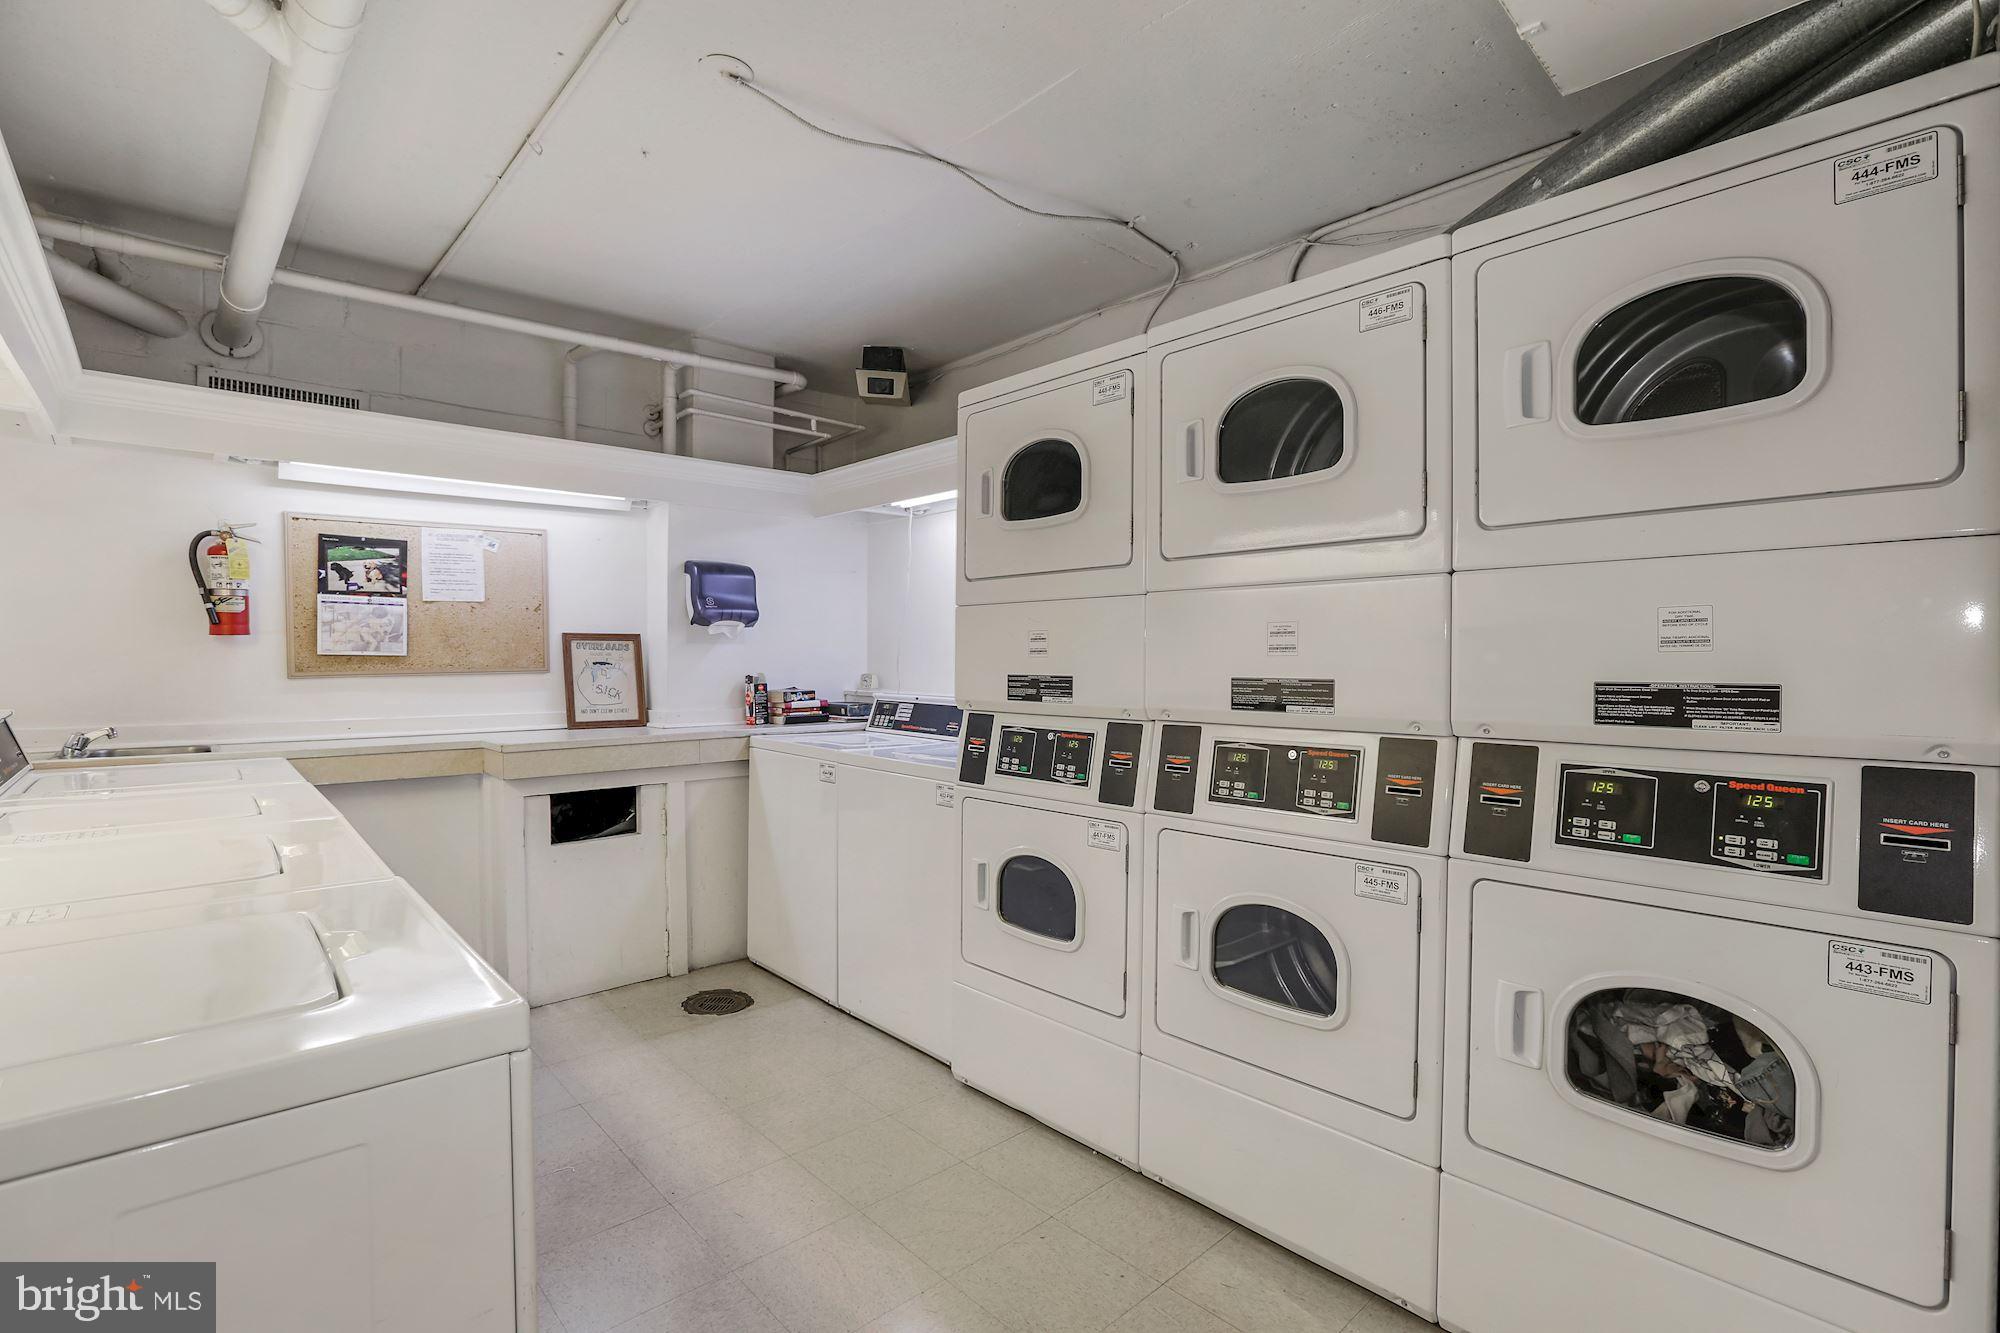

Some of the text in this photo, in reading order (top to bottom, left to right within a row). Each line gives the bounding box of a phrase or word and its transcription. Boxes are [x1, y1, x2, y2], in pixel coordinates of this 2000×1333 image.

[1837, 156, 1862, 167] CSC
[1851, 154, 1921, 181] 444-FMS
[1368, 301, 1404, 317] 446-FMS
[595, 684, 623, 700] SICK
[1232, 753, 1246, 762] 125
[1318, 760, 1334, 770] 125
[1592, 782, 1614, 794] 125
[1728, 780, 1805, 794] Speed Queen
[1747, 794, 1773, 808] 125
[1363, 876, 1400, 890] 445-FMS
[1832, 944, 1857, 953] CSC
[1845, 961, 1915, 982] 443-FMS
